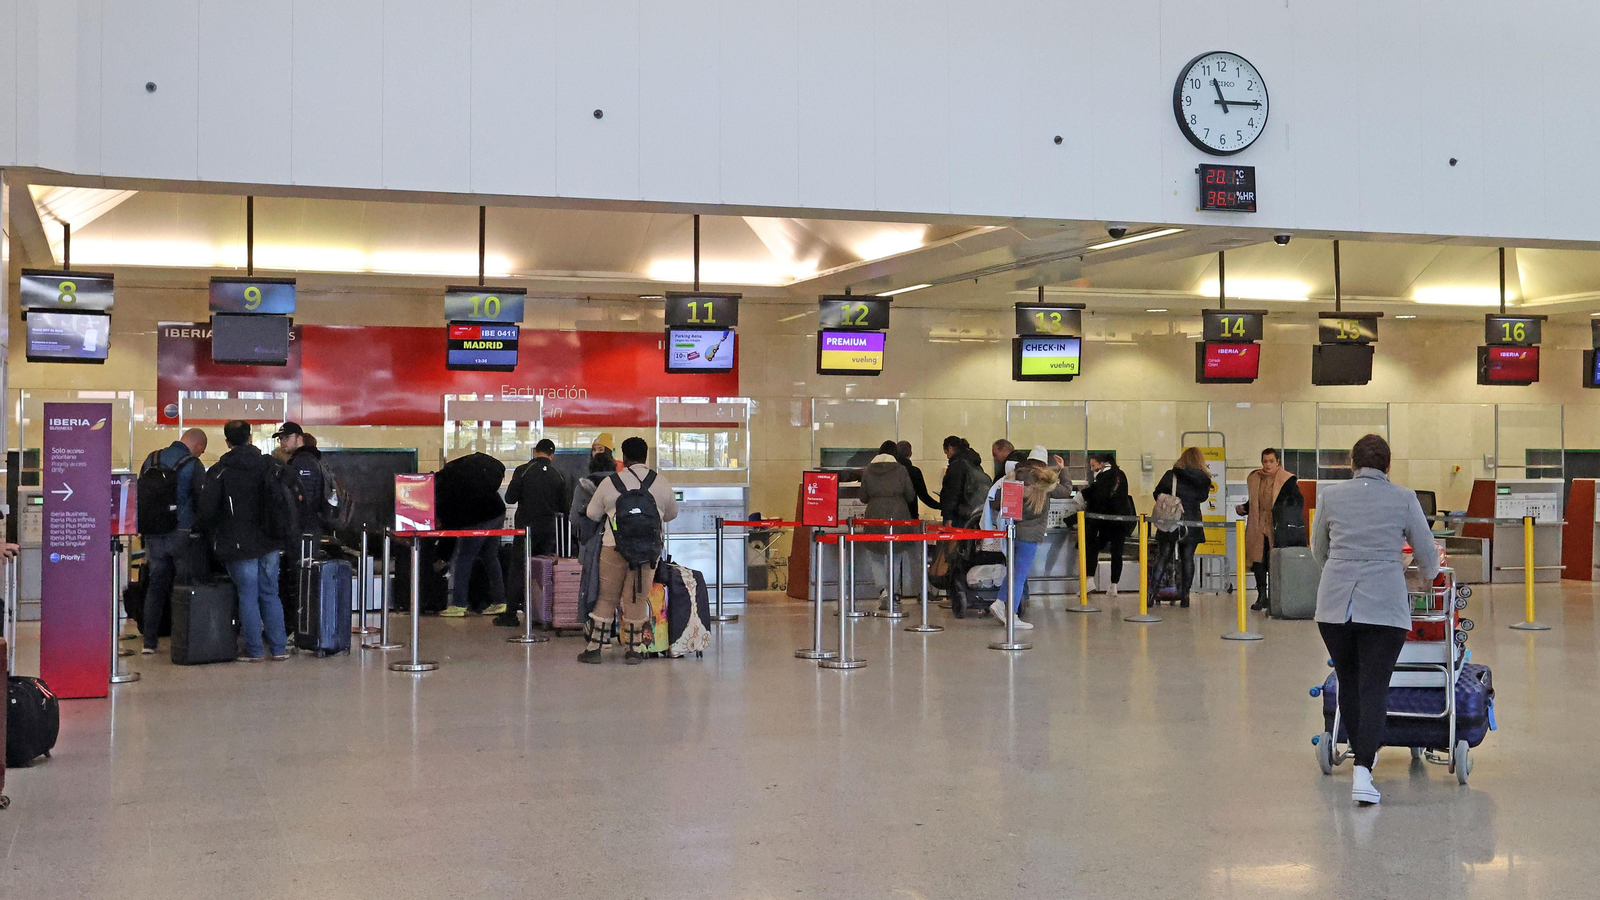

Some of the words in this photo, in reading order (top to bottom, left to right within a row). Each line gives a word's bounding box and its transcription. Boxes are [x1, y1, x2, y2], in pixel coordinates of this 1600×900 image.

[1202, 65, 1211, 76] 11
[1216, 61, 1227, 73] 12
[1236, 67, 1240, 78] 1
[1190, 78, 1201, 90] 10
[1209, 80, 1235, 88] SEIKO
[1247, 80, 1253, 91] 2
[1185, 95, 1192, 107] 9
[1190, 114, 1197, 125] 8
[1247, 117, 1255, 128] 4
[1203, 128, 1210, 139] 7
[1219, 134, 1226, 145] 6
[1236, 130, 1242, 142] 5
[58, 282, 76, 306] 8
[244, 286, 262, 310] 9
[468, 296, 500, 318] 10
[687, 301, 716, 323] 11
[841, 304, 869, 326] 12
[1035, 311, 1063, 333] 13
[1220, 317, 1246, 338] 14
[1336, 320, 1361, 340] 15
[1501, 322, 1526, 342] 16
[826, 337, 867, 347] PREMIUM
[1025, 343, 1066, 352] CHECK-IN
[852, 356, 877, 365] vueling
[1050, 361, 1075, 371] vueling
[502, 384, 587, 400] Facturación
